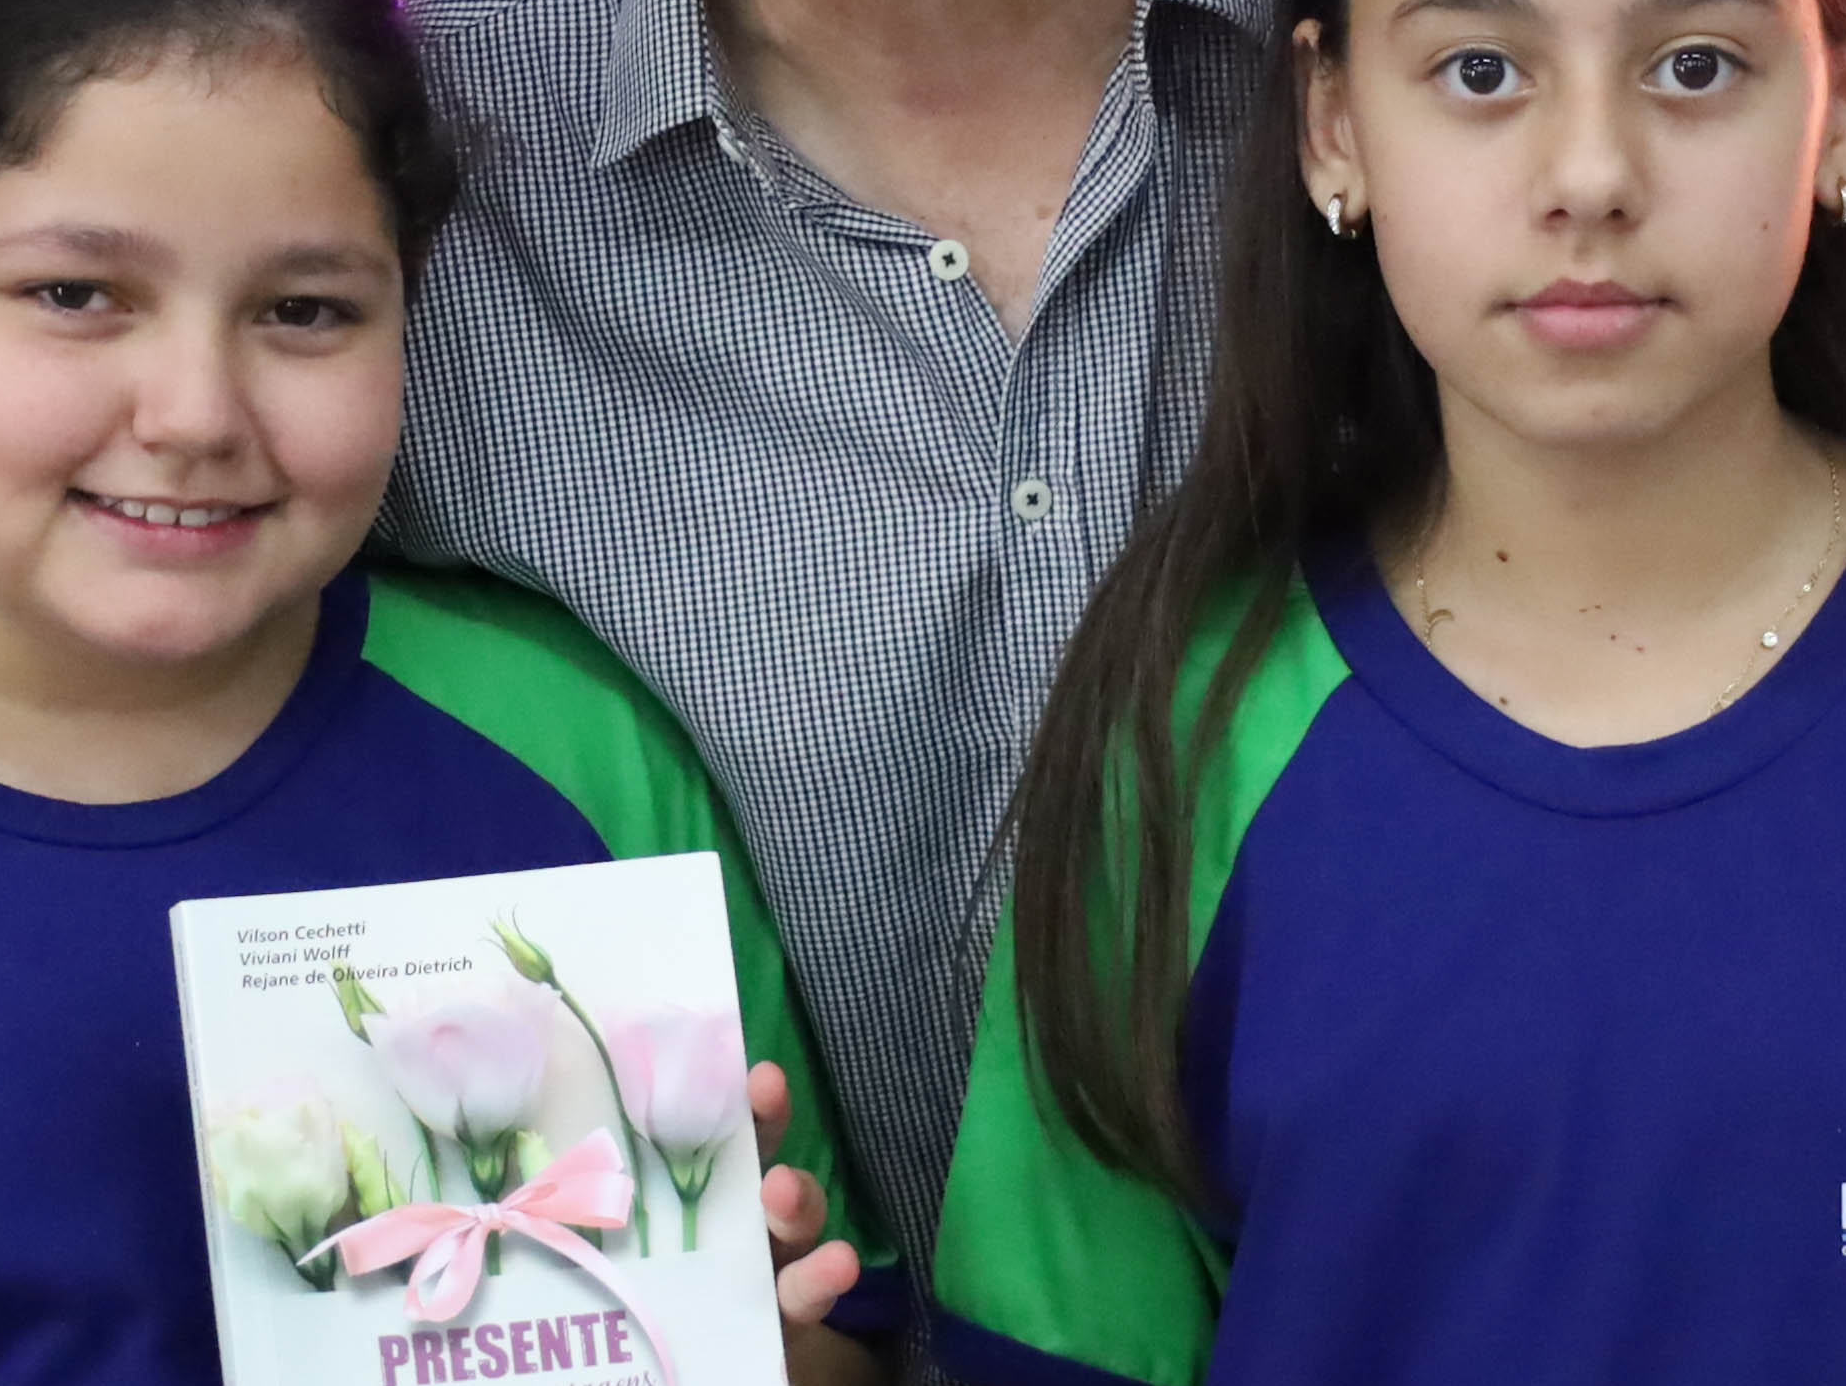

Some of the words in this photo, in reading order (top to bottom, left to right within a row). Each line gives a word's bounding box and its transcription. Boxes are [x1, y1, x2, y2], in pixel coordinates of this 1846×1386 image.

[238, 929, 289, 944] Vilson
[295, 921, 367, 941] Cechetti
[240, 949, 297, 966] Viviani
[304, 944, 351, 962] Wolff
[242, 975, 299, 991] Rejane
[306, 969, 326, 984] de
[333, 964, 398, 983] Oliveira
[405, 956, 473, 976] Dietrich
